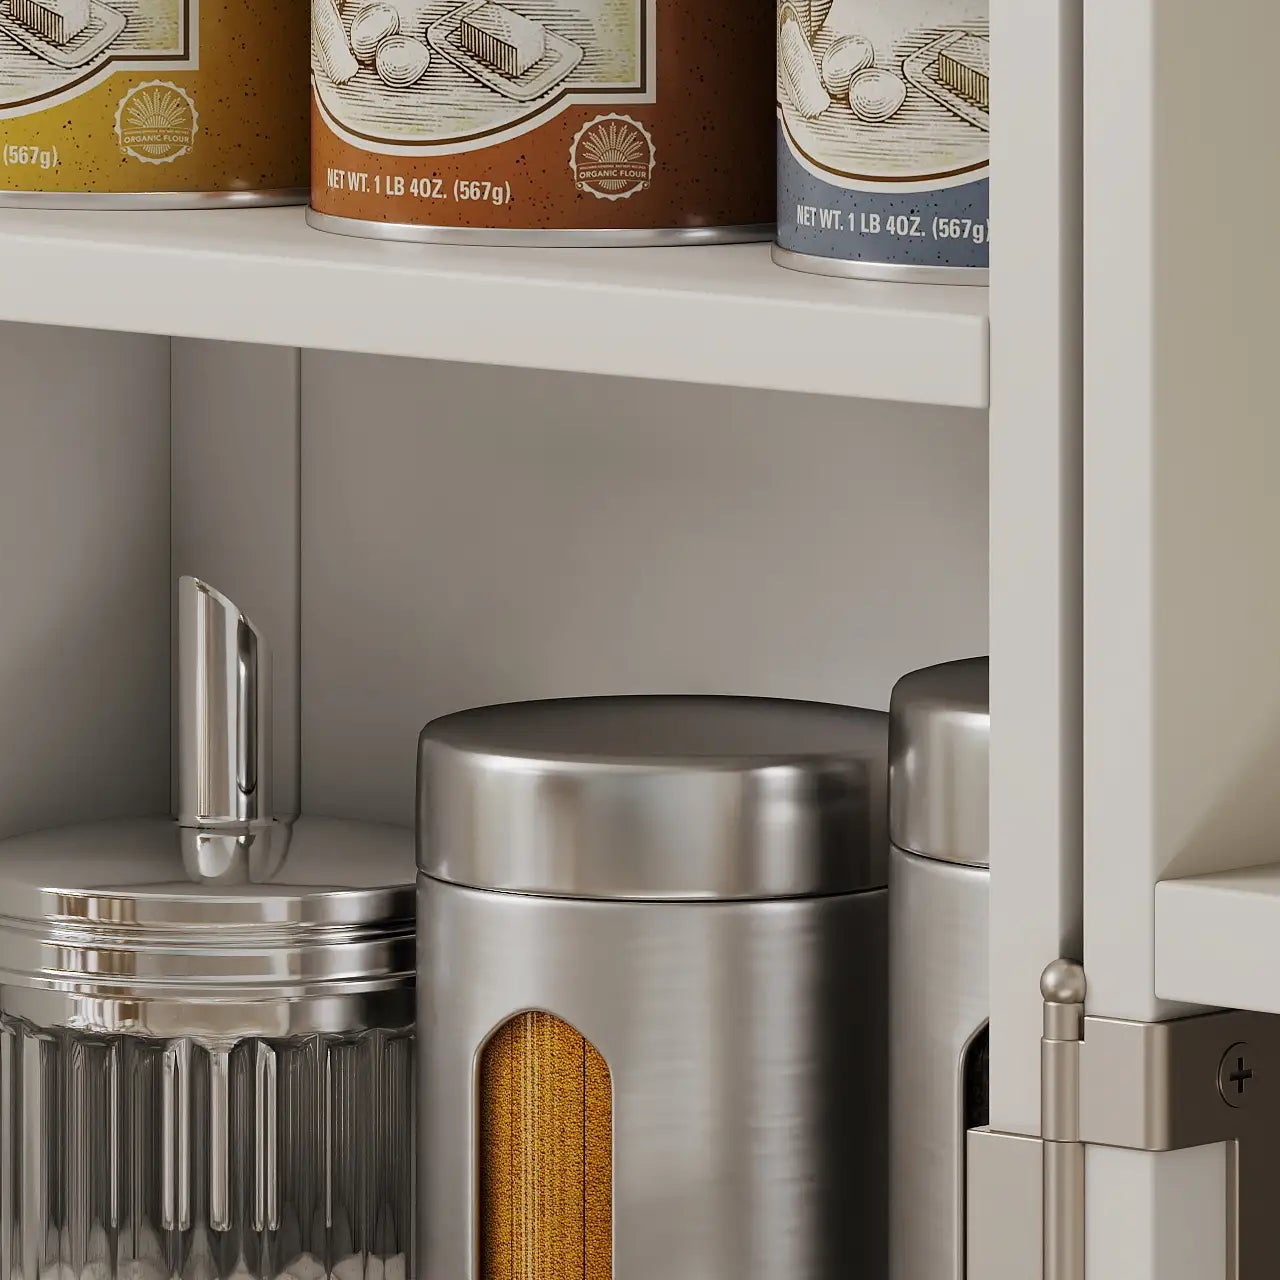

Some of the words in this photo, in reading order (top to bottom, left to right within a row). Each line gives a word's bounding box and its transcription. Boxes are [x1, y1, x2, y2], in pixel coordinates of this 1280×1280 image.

[123, 134, 161, 144] ORGANIC
[163, 135, 190, 144] FLOUR
[3, 144, 58, 169] (567g)
[327, 167, 345, 189] NET
[347, 172, 370, 193] WT.
[374, 176, 380, 194] 1
[386, 176, 405, 196] LB
[453, 179, 511, 206] (567g)
[580, 170, 618, 179] ORGANIC
[620, 170, 647, 178] FLOUR
[797, 205, 816, 226] NET
[820, 208, 843, 230] WT.
[848, 213, 854, 231] 1
[861, 213, 880, 234] LB
